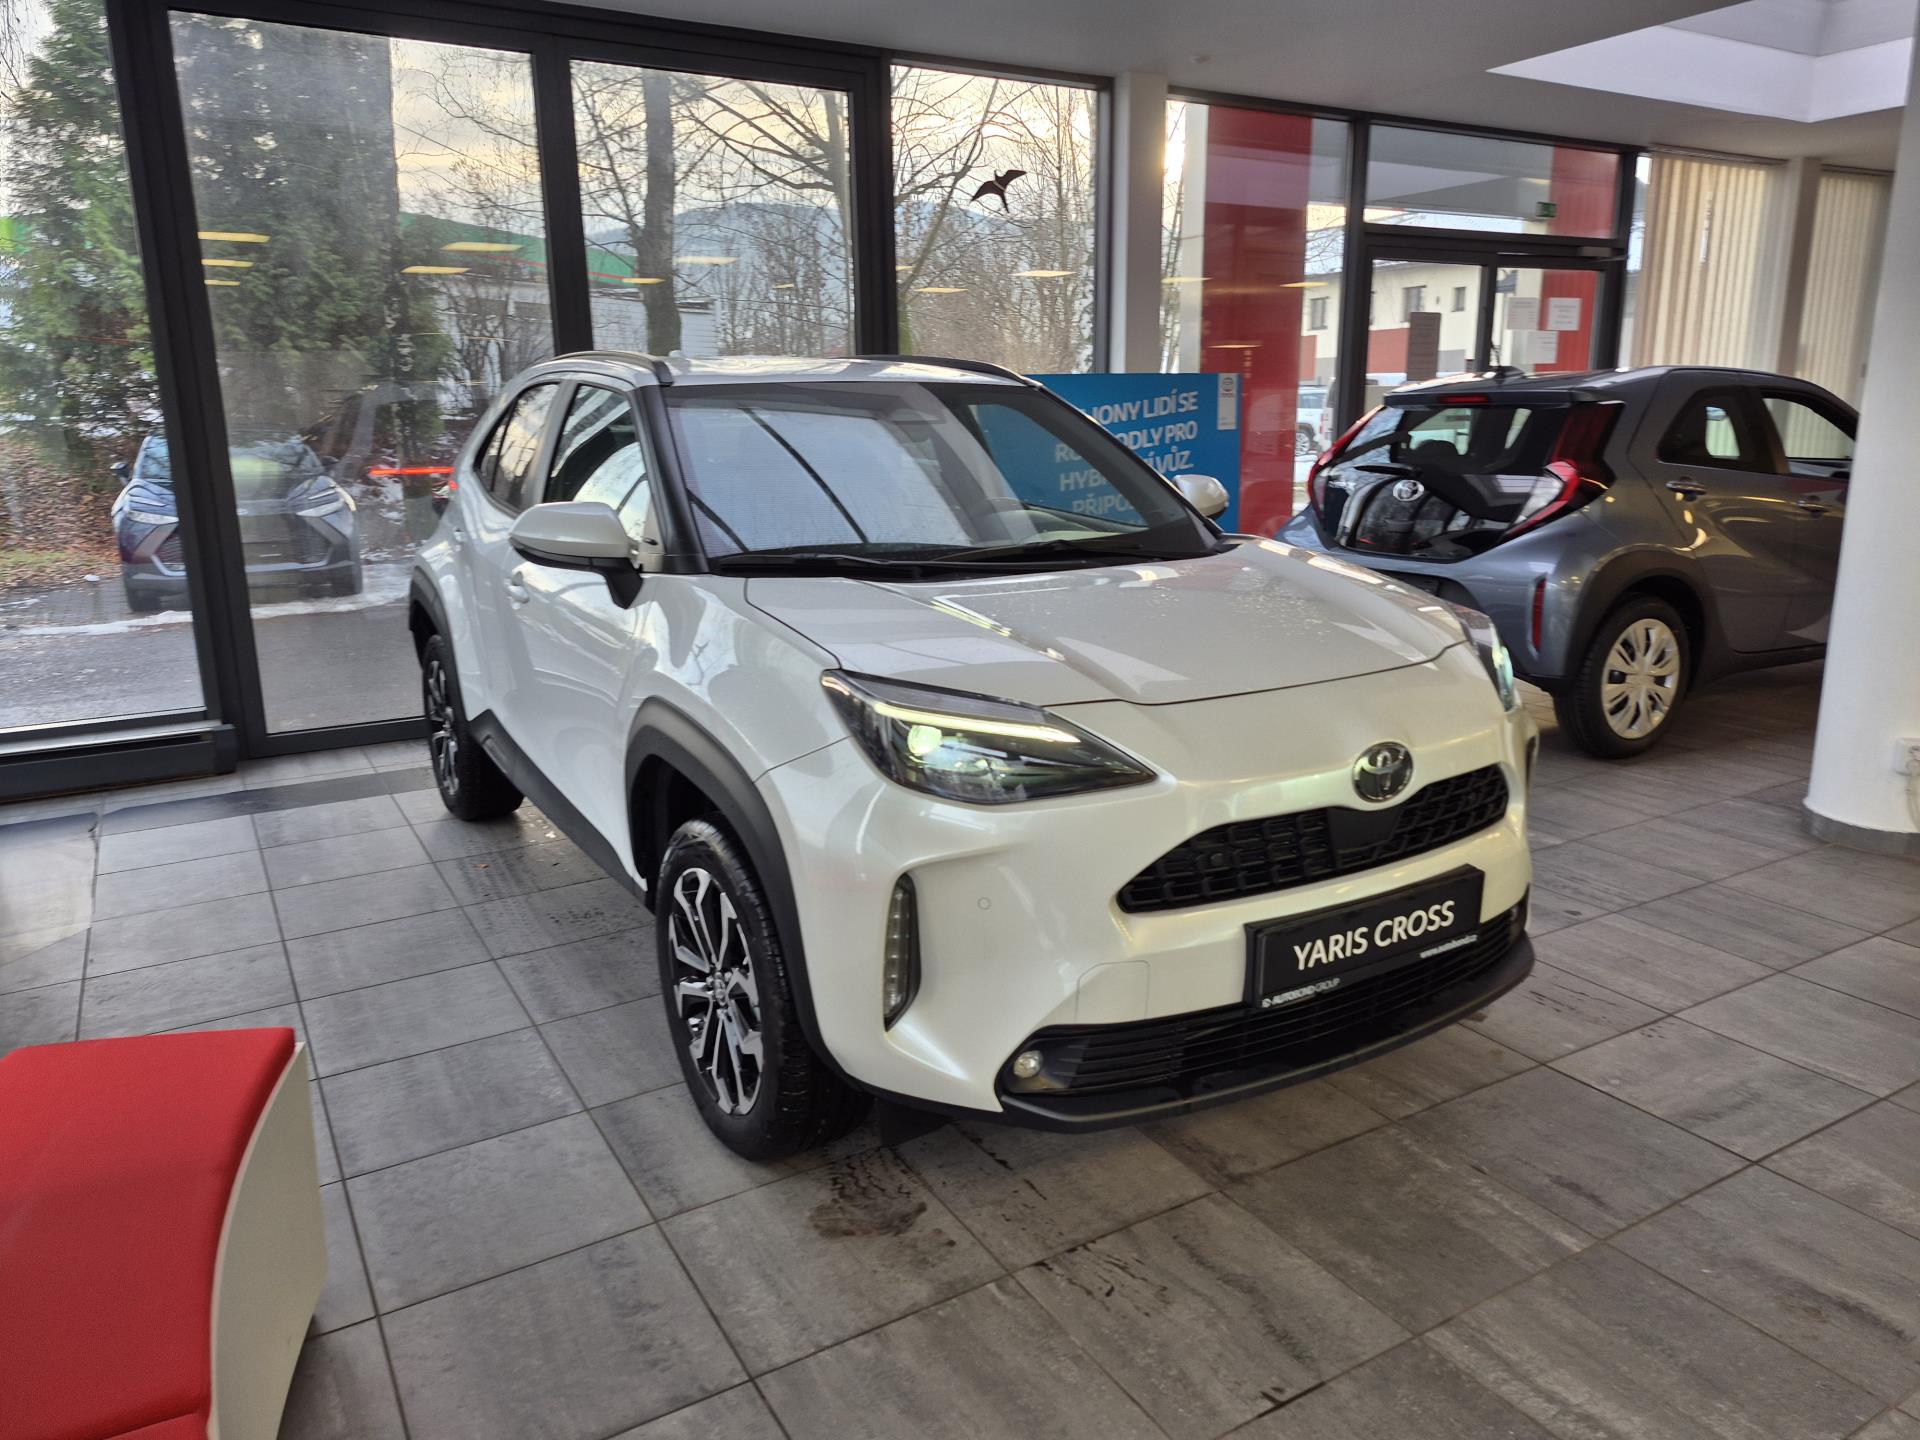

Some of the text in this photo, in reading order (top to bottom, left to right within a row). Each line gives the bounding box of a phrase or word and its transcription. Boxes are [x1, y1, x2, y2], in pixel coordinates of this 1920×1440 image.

[1143, 389, 1177, 419] LIDÍ
[1178, 391, 1199, 413] SE
[1165, 420, 1198, 444] PRO
[1293, 926, 1369, 971] YARIS
[1374, 900, 1455, 948] CROSS
